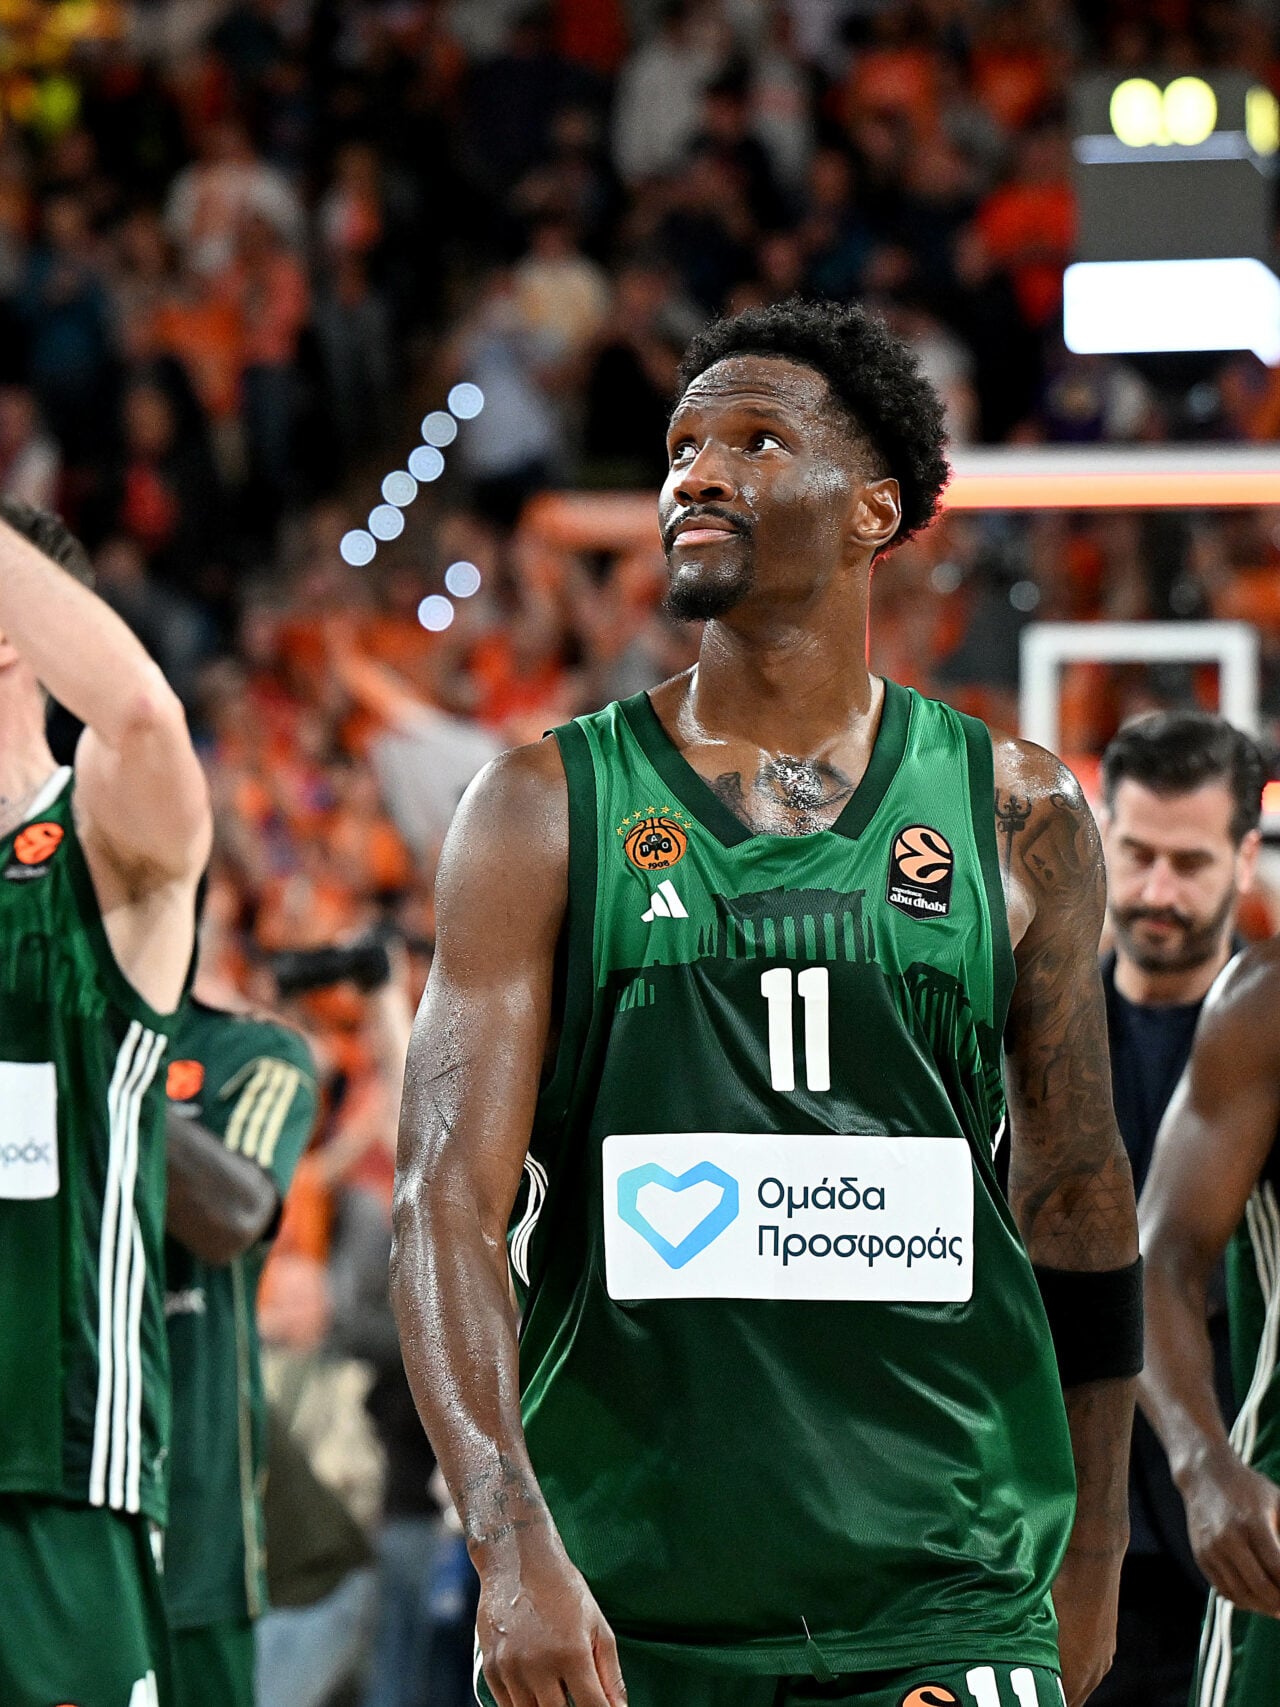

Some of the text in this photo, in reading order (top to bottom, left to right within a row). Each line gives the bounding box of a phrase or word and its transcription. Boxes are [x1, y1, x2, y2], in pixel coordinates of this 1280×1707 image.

[647, 859, 670, 870] 1908
[889, 893, 947, 914] abu dhabi
[760, 966, 831, 1092] 11
[757, 1177, 886, 1219] Ομάδα
[757, 1225, 963, 1268] Προσφοράς
